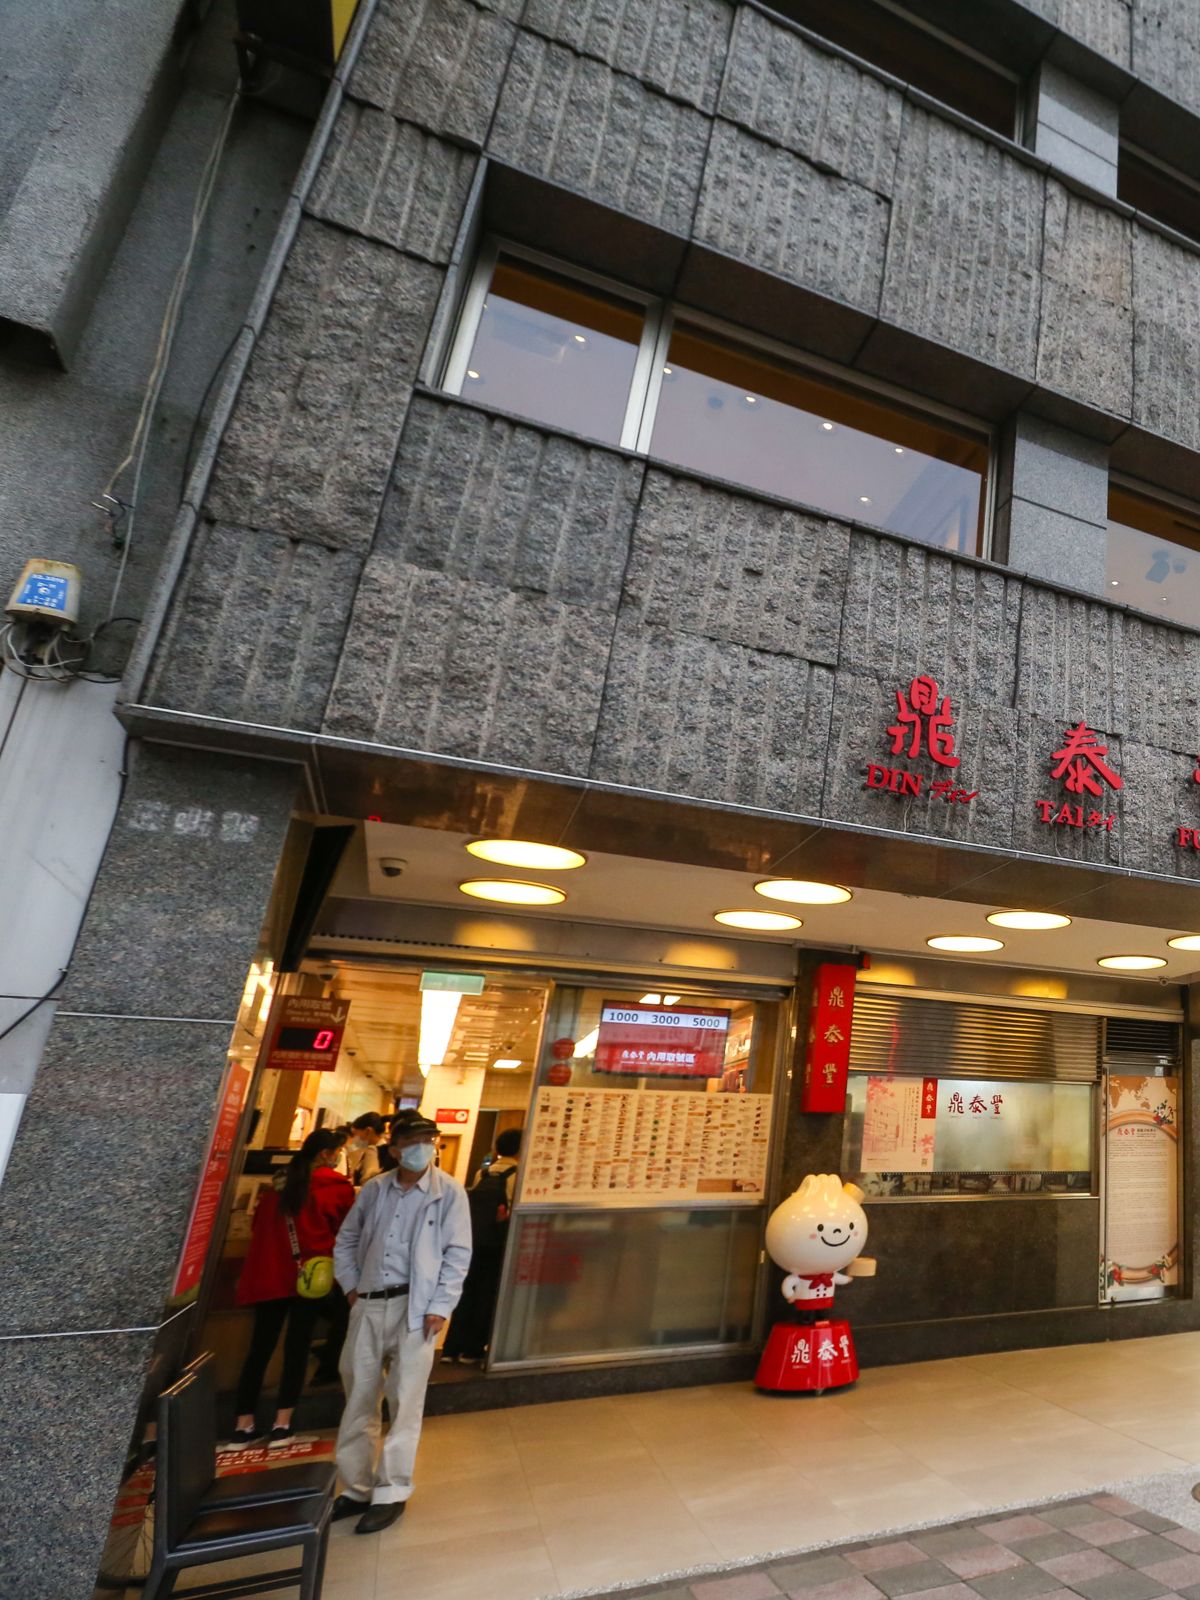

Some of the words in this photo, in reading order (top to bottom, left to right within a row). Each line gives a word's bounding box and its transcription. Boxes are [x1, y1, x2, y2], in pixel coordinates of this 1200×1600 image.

[866, 764, 923, 797] DIN
[1036, 800, 1083, 828] TAI
[1086, 811, 1117, 832] タイ
[609, 1012, 639, 1023] 1000
[651, 1014, 680, 1025] 3000
[692, 1017, 720, 1028] 5000
[313, 1030, 334, 1049] 0
[821, 985, 845, 1084] 鼎泰豐
[948, 1092, 1003, 1115] 鼎泰豐
